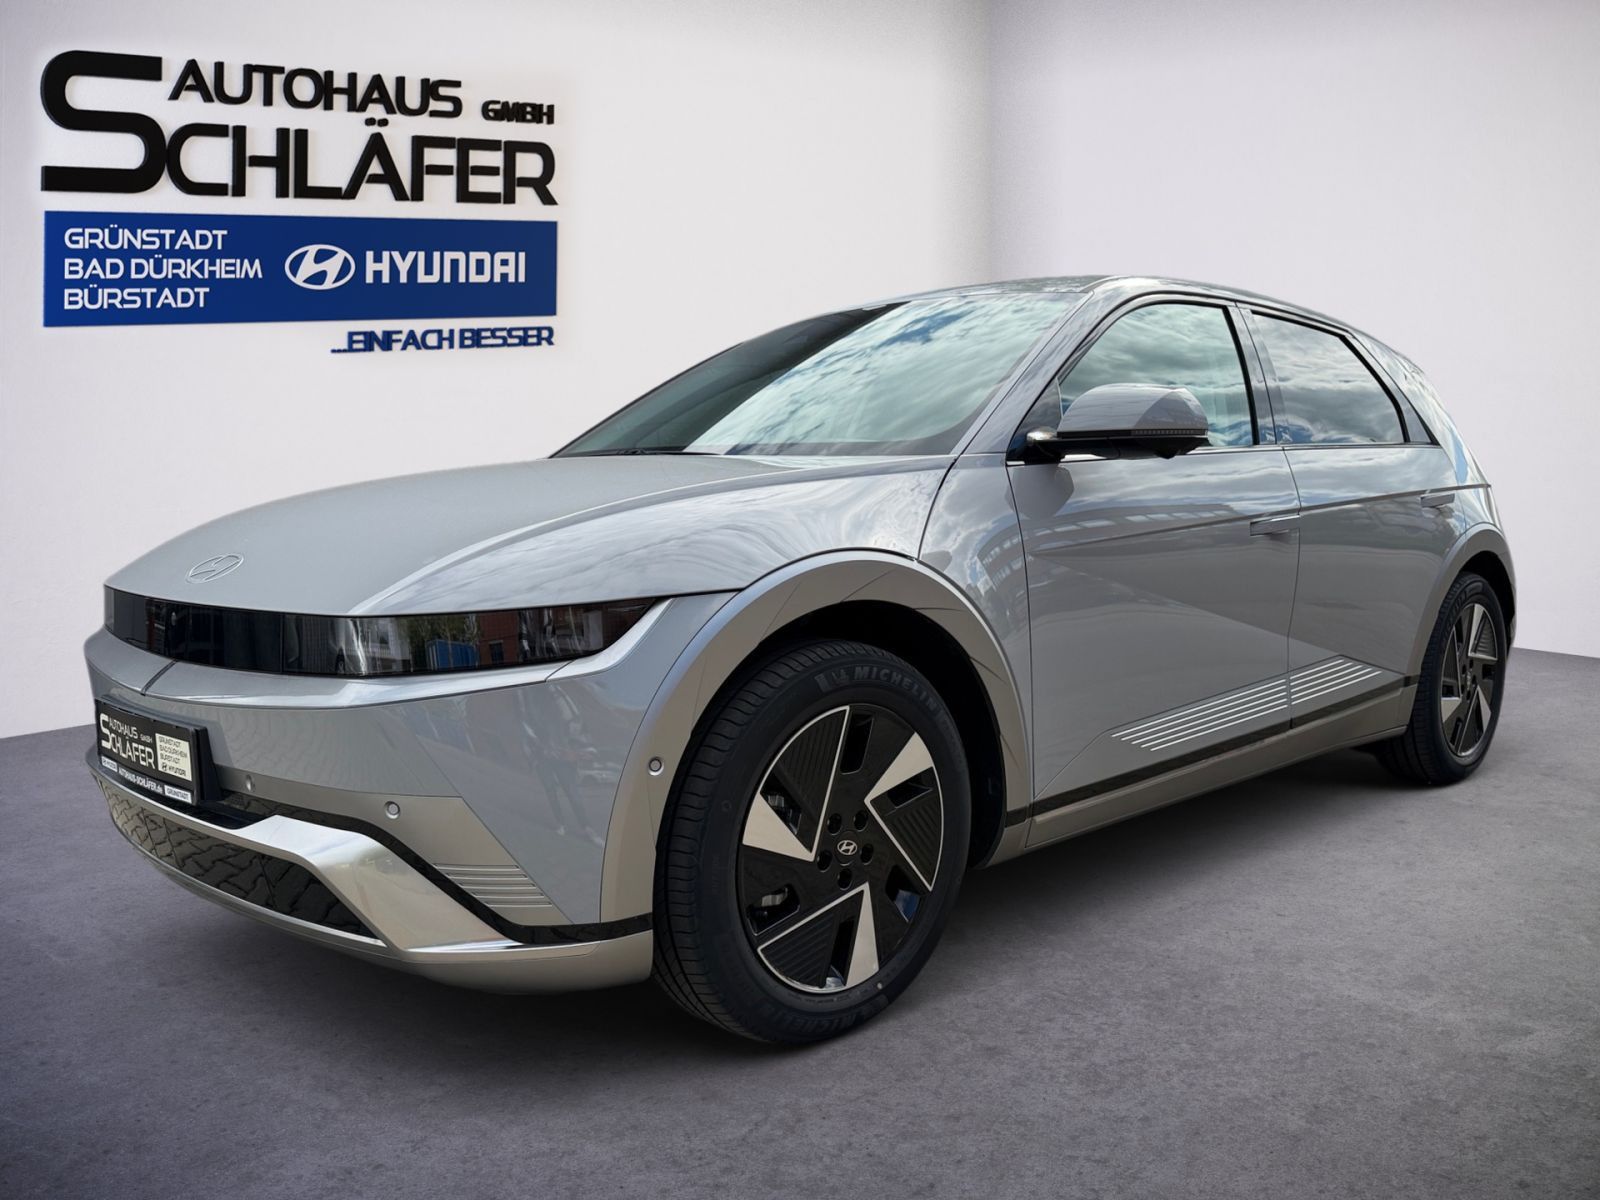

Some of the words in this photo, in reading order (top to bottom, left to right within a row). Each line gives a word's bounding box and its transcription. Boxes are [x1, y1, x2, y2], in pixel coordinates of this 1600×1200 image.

[168, 59, 463, 119] AUTOHAUS
[481, 100, 555, 125] GMBH
[40, 50, 558, 205] SCHLÄFER
[64, 224, 228, 251] GRÜNSTADT
[64, 258, 124, 280] BAD
[130, 254, 263, 280] DÜRKHEIM
[365, 250, 526, 284] HYUNDAI
[63, 284, 210, 310] BÜRSTADT
[458, 326, 555, 349] BESSER
[854, 666, 937, 711] MICHELIN
[100, 713, 155, 769] SCHLÄFER
[109, 718, 138, 739] AUTOHAUS
